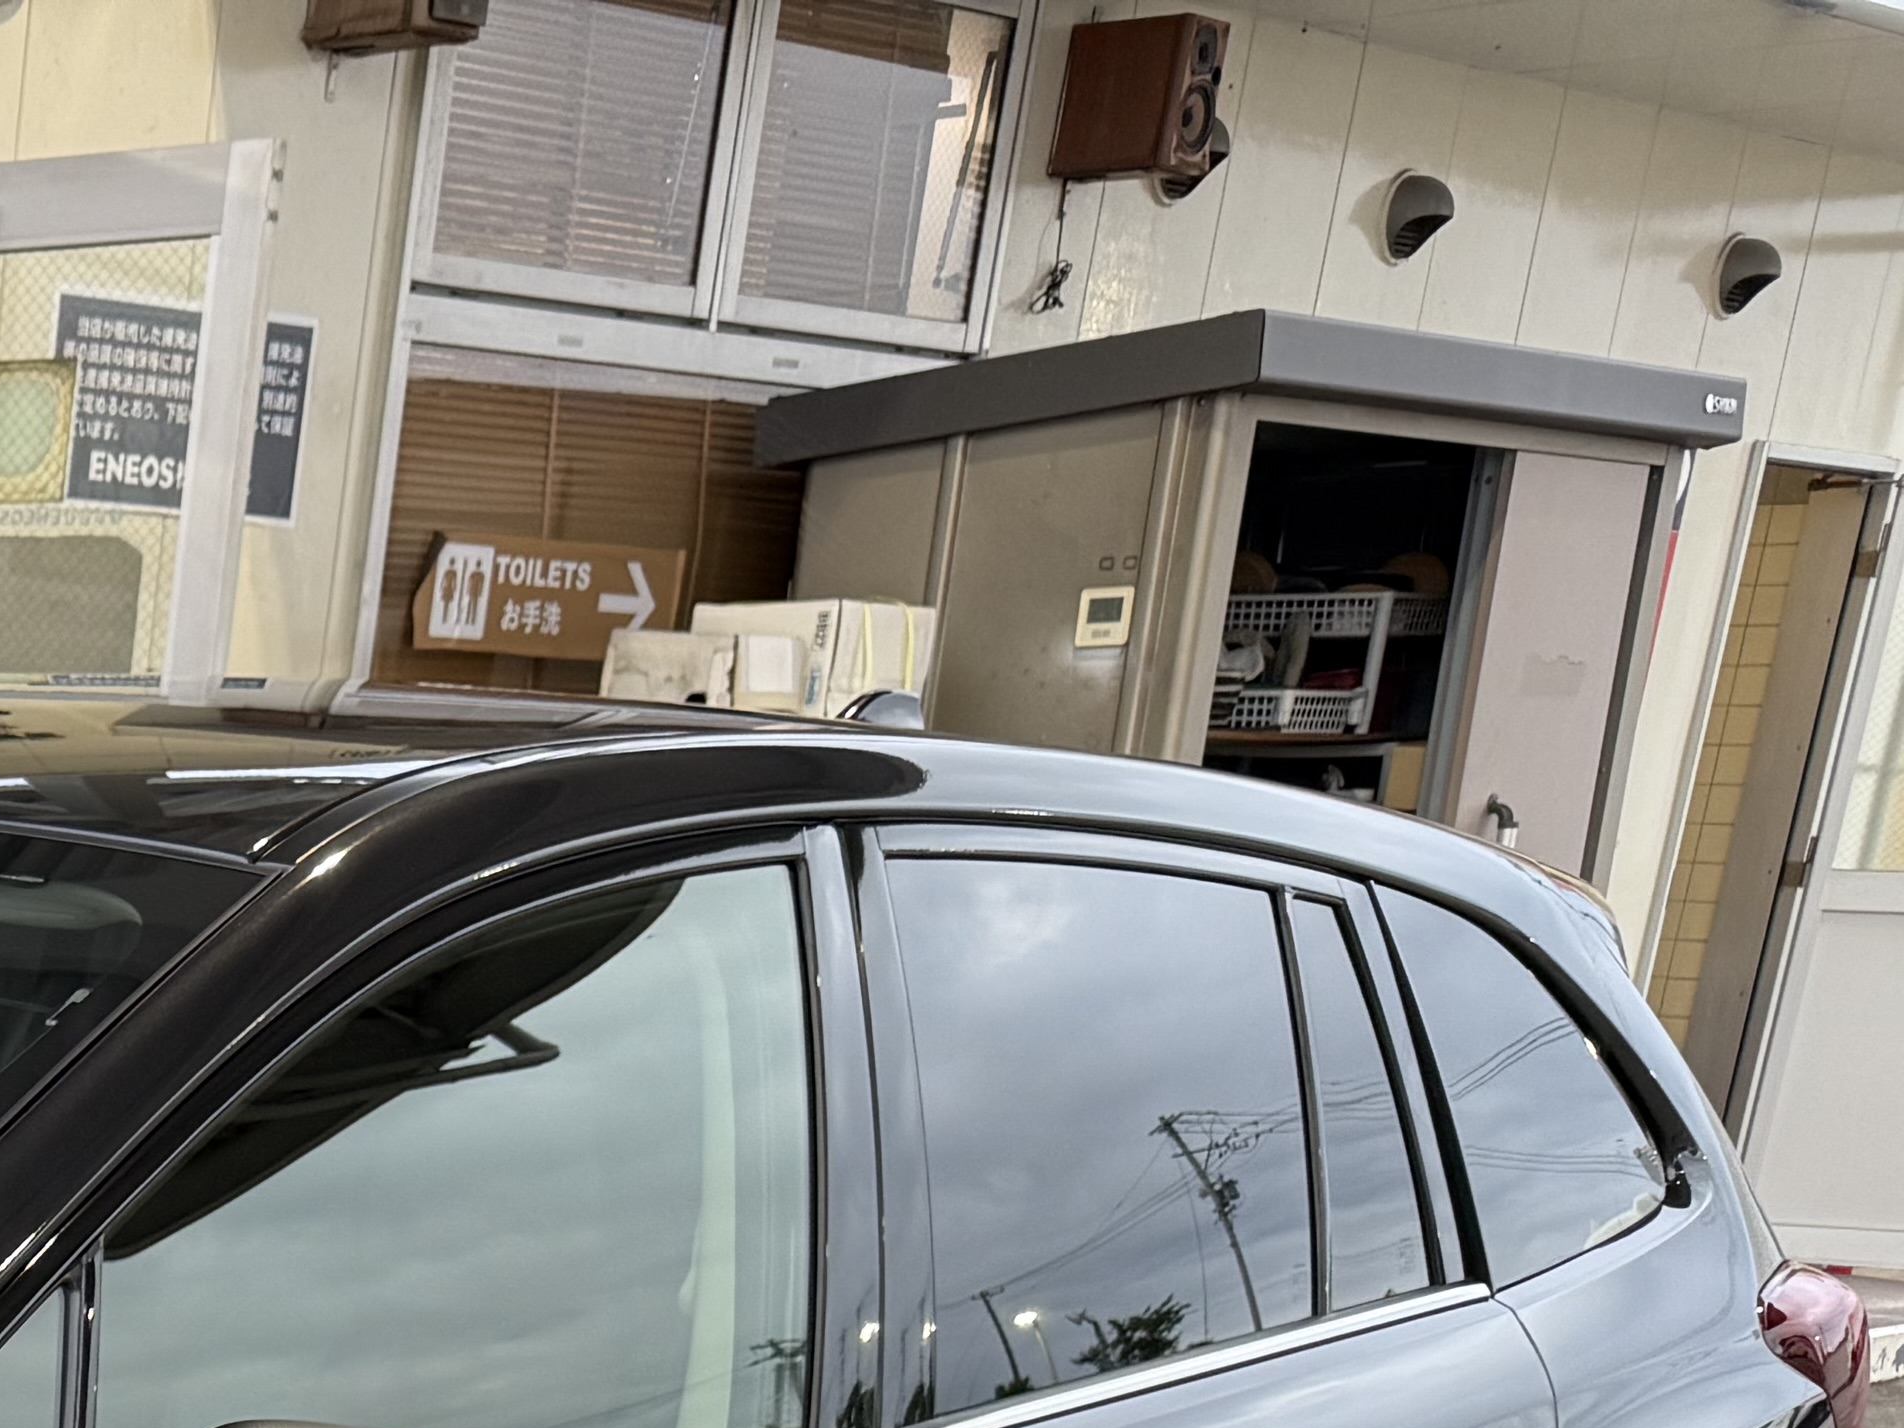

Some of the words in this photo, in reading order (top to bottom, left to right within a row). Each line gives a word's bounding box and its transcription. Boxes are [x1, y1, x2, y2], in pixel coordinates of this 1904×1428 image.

[495, 554, 592, 592] TOILETS
[500, 600, 561, 636] お手洗
